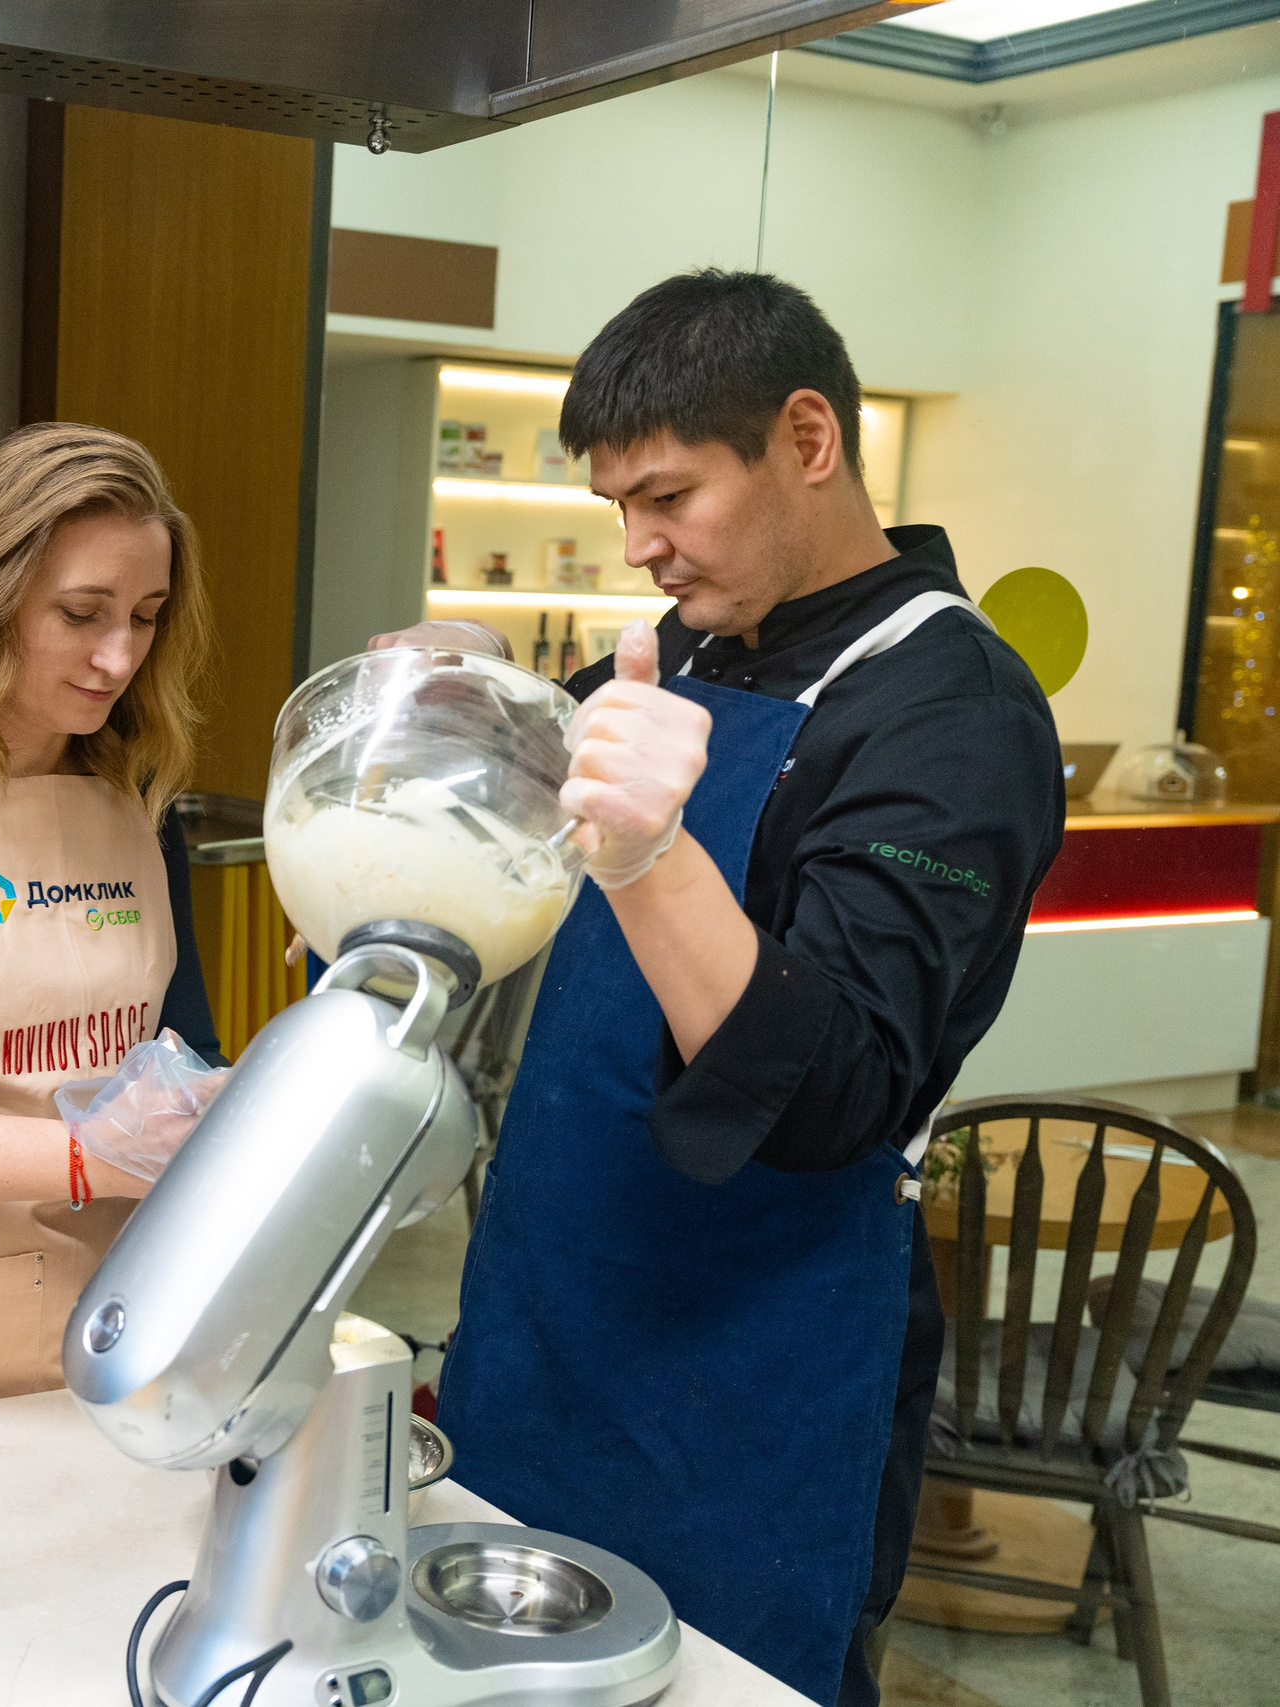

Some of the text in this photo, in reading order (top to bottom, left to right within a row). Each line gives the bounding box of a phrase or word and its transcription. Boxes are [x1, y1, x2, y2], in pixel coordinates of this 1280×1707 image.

[27, 881, 136, 909] Домклик
[106, 909, 141, 926] СБЕР
[2, 1016, 80, 1075] NOVIKOV
